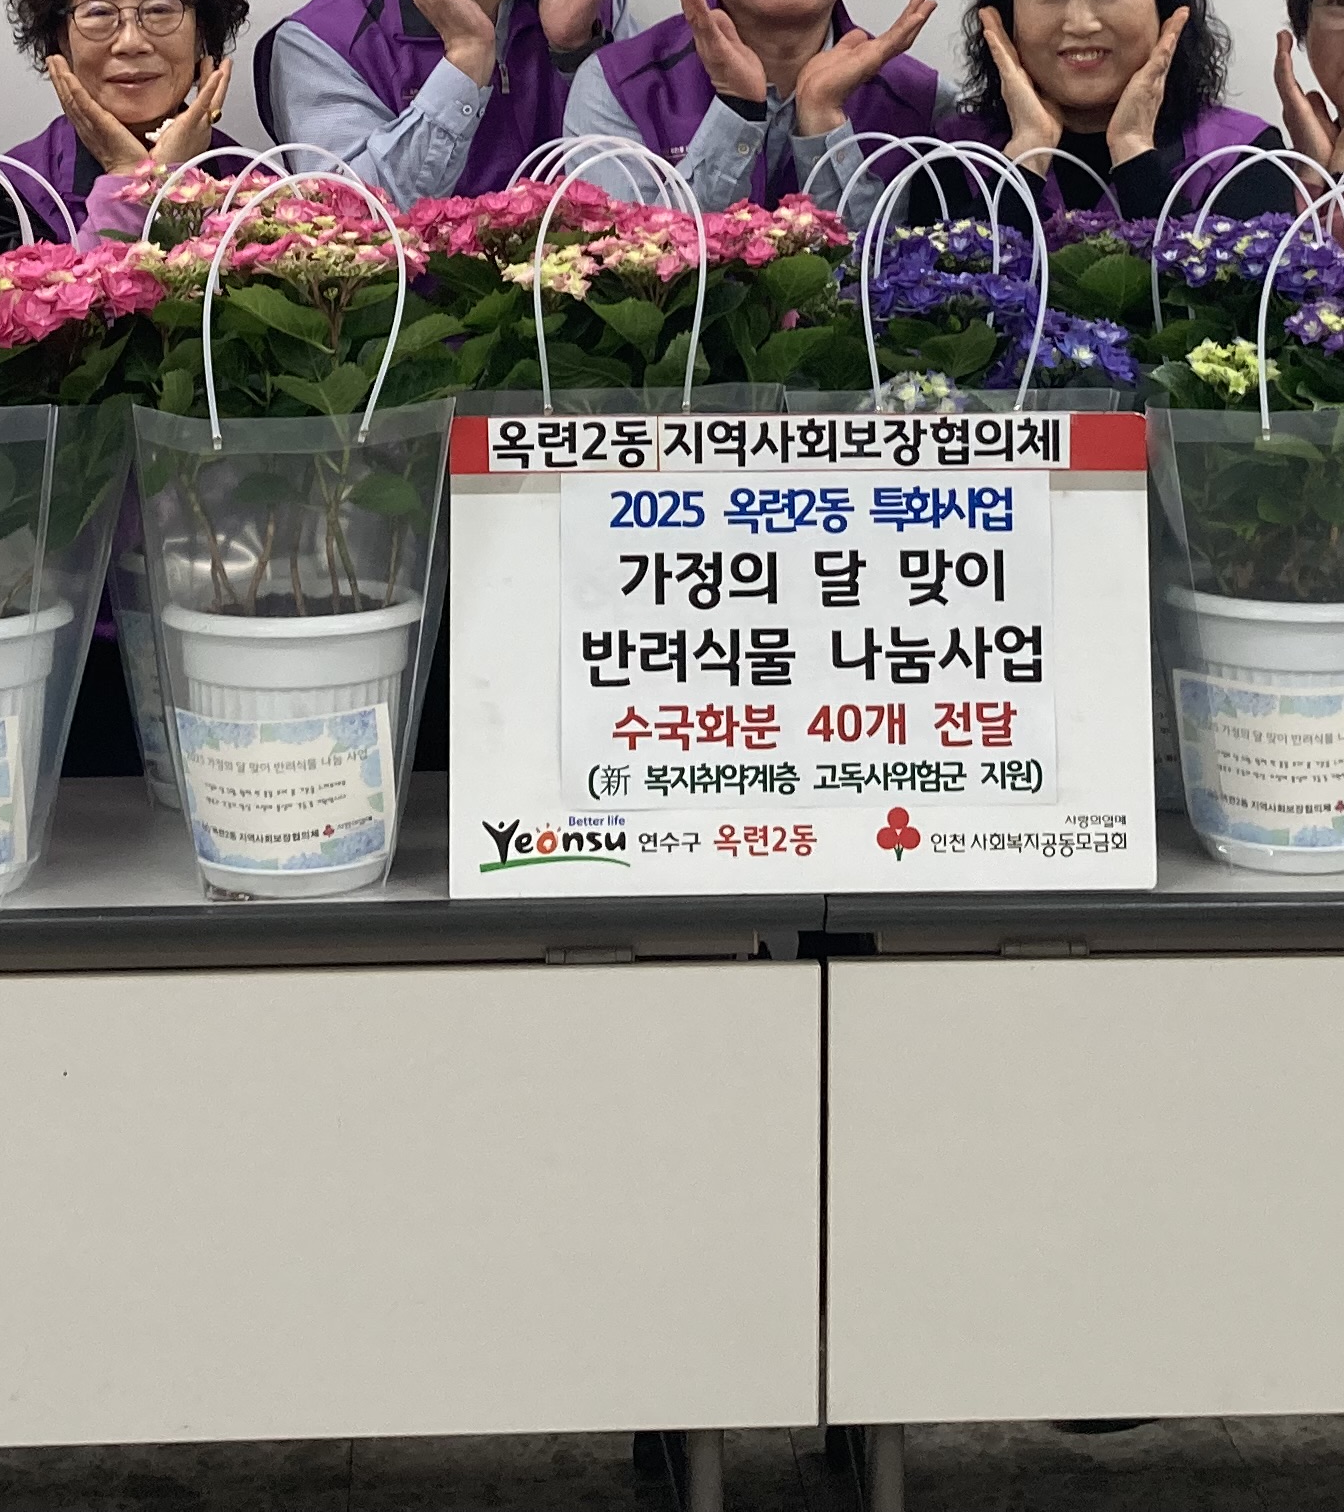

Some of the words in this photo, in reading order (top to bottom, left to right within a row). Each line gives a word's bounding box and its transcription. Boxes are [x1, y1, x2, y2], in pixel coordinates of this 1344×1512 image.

[493, 421, 652, 468] 옥련2동
[664, 418, 1059, 467] 지역사회보장협의체
[610, 491, 705, 528] 2025
[724, 488, 854, 534] 옥련2동
[870, 486, 1012, 532] 특화사업
[620, 552, 777, 610] 가정의
[815, 550, 866, 607] 달
[900, 549, 1004, 606] 맞이
[583, 628, 795, 687] 반려식물
[832, 626, 1042, 684] 나눔사업
[613, 703, 780, 751] 수국화분
[808, 704, 906, 745] 40개
[934, 702, 1017, 747] 전달
[589, 765, 630, 800] (新
[645, 762, 800, 796] 복지취약계층
[814, 760, 967, 793] 고독사위험군
[981, 759, 1042, 794] 지원)
[482, 819, 627, 865] Yeonsu
[569, 817, 604, 826] Better
[608, 815, 625, 826] life
[639, 833, 701, 852] 연수구
[714, 825, 817, 856] 옥련2동
[931, 834, 965, 852] 인천
[971, 832, 1126, 857] 사회복지공동모금회
